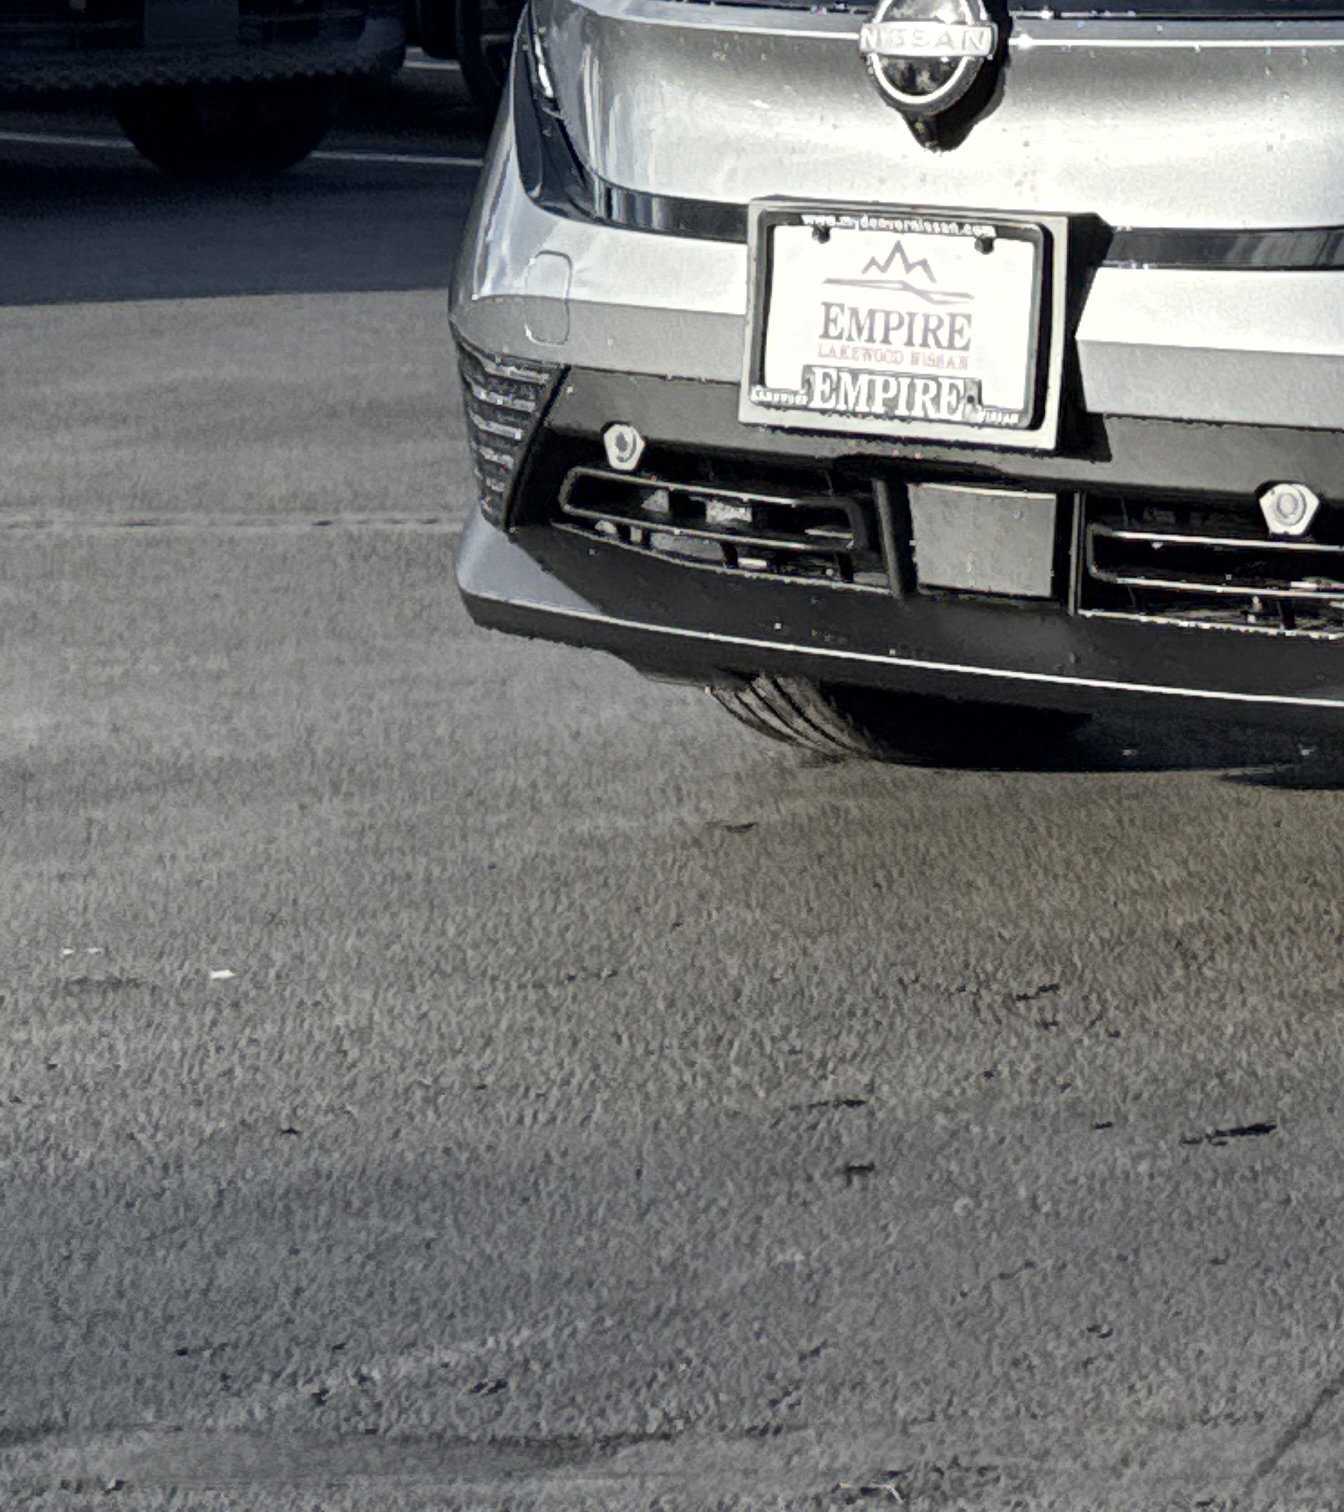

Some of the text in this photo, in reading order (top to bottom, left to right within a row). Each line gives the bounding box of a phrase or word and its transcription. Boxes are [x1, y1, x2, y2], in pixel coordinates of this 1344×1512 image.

[861, 25, 989, 51] NISSAN
[818, 301, 972, 352] EMPIRE
[807, 366, 965, 421] EMPIRE
